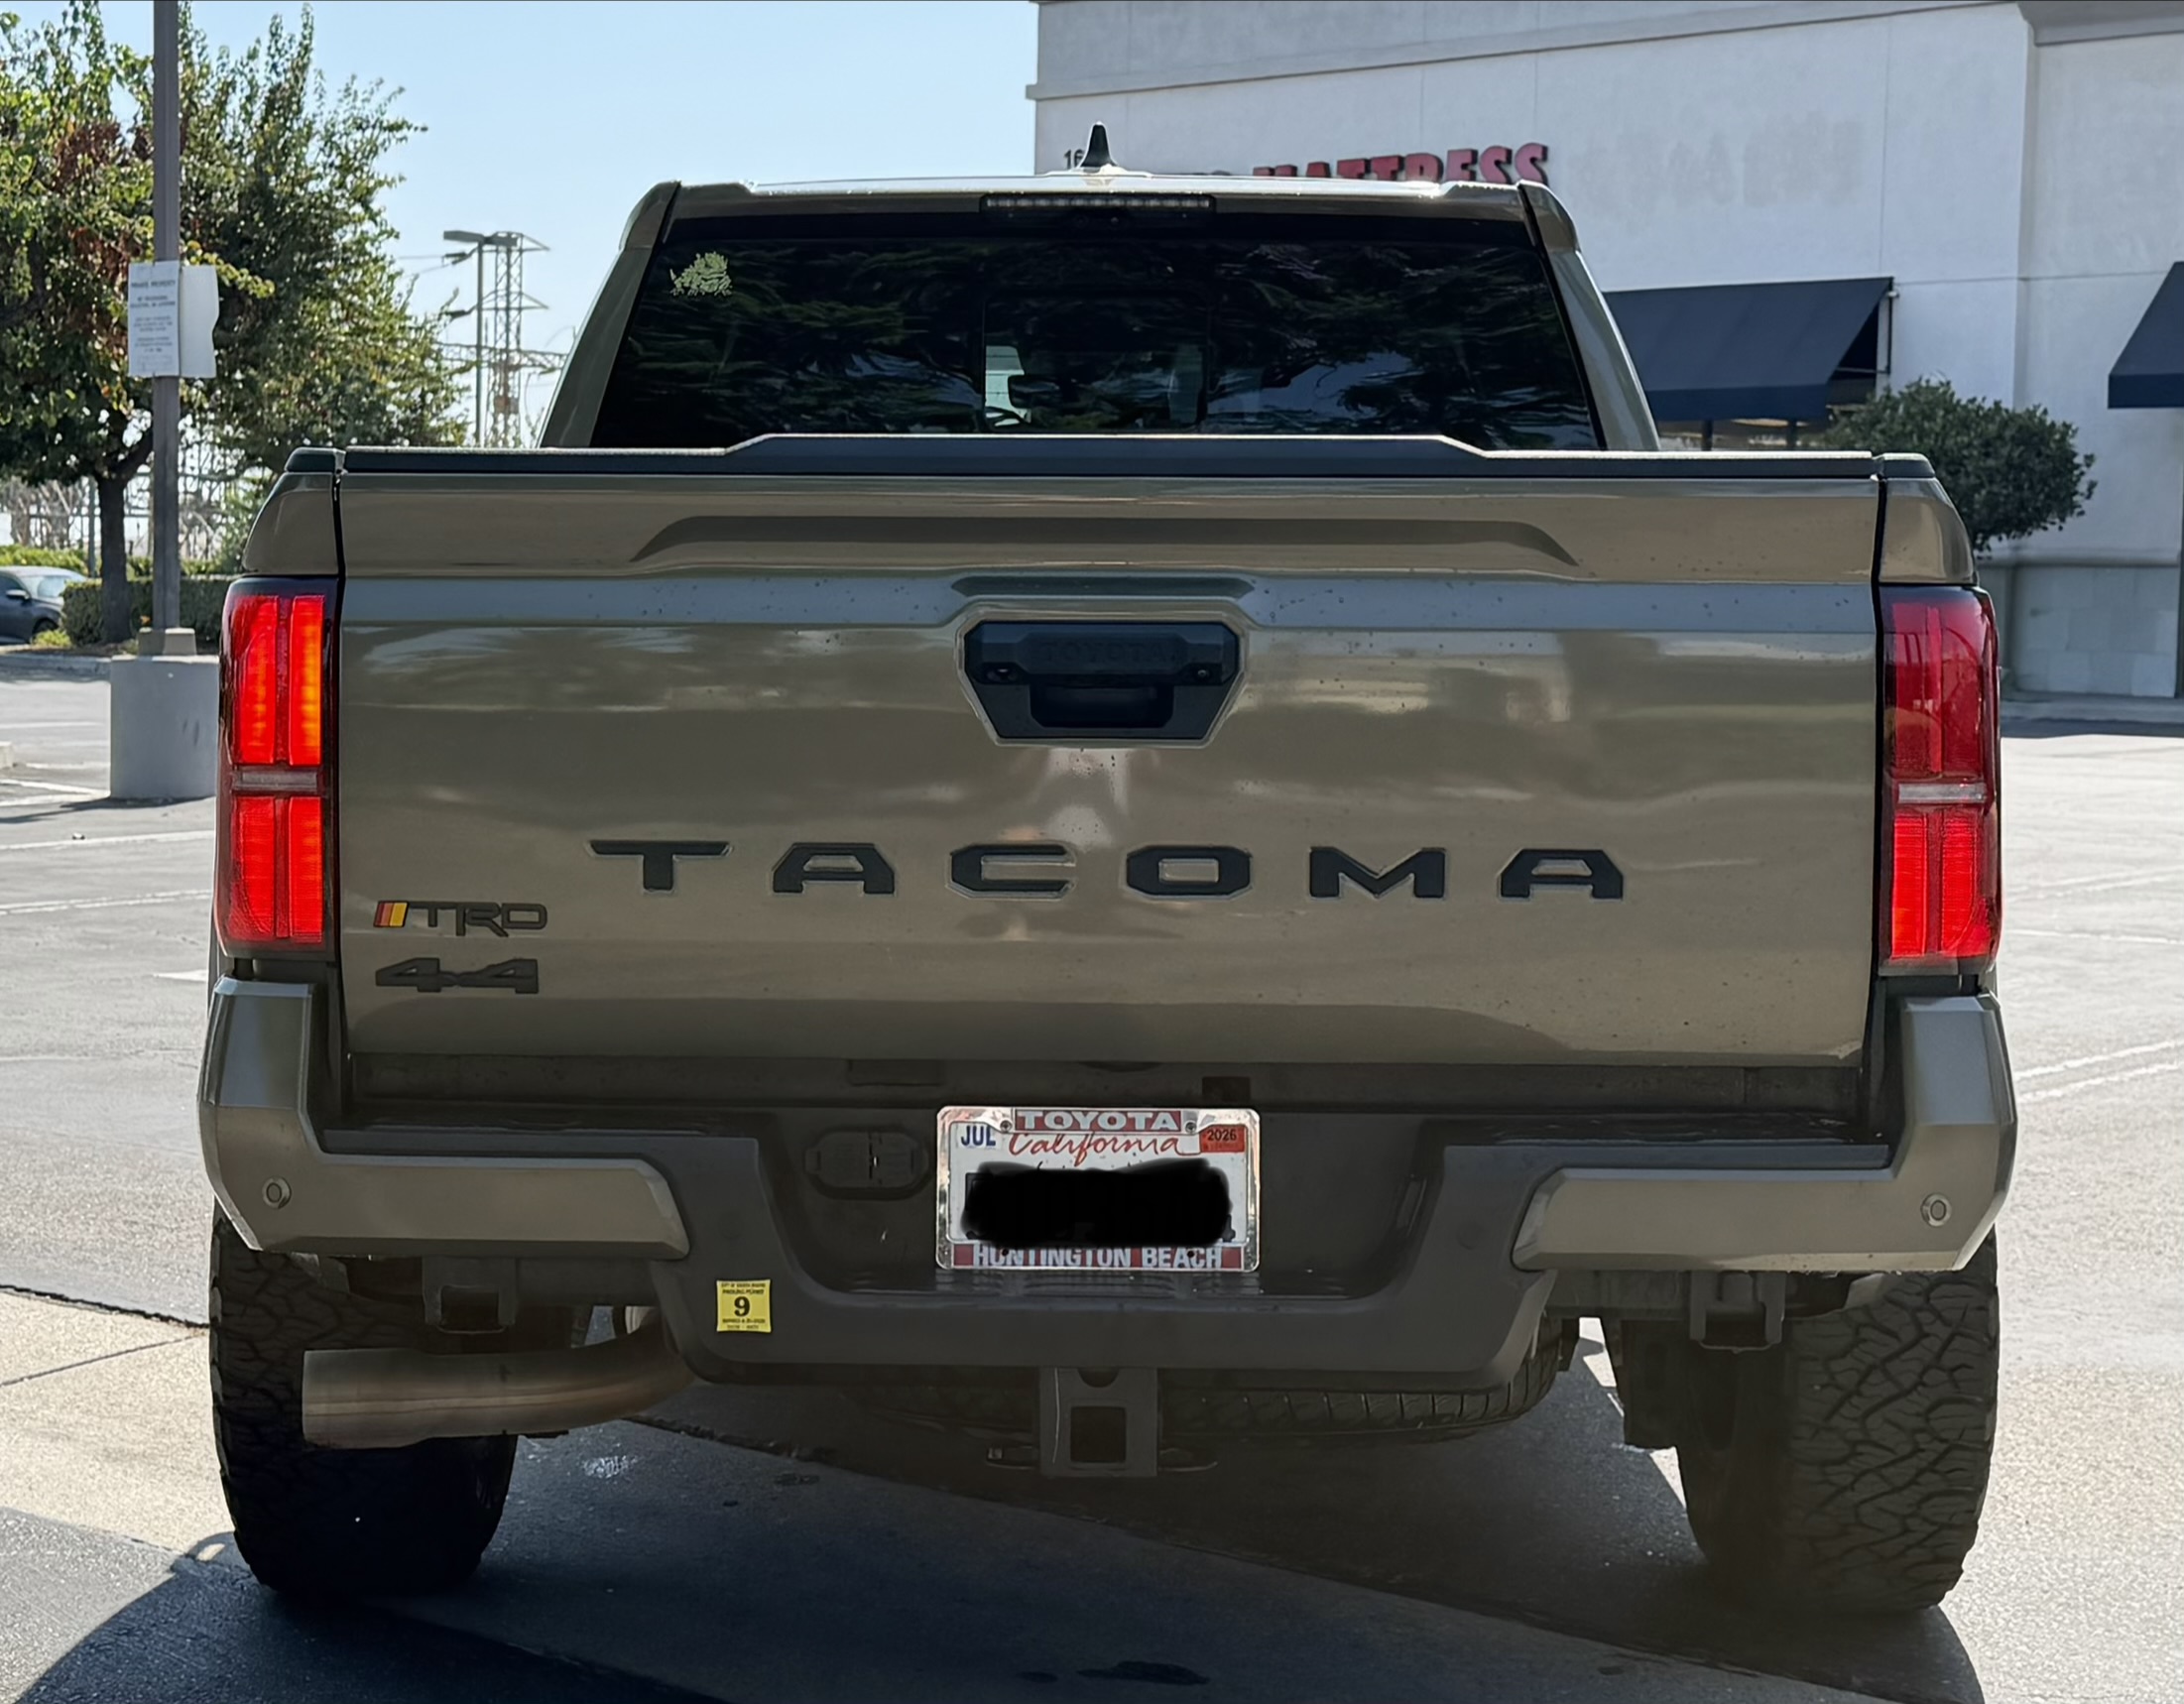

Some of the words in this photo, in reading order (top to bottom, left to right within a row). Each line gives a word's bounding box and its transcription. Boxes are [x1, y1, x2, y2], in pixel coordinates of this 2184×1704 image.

[1253, 142, 1548, 184] TTRESS
[589, 839, 1625, 901] TACOMA
[408, 902, 547, 937] TRD
[1017, 1110, 1178, 1131] TOYOTA
[960, 1125, 997, 1147] JUL
[1207, 1128, 1237, 1142] 2026
[1009, 1133, 1182, 1166] California
[973, 1244, 1132, 1269] HUNTINGTON
[1142, 1247, 1223, 1270] BEACH
[734, 1295, 751, 1317] 9
